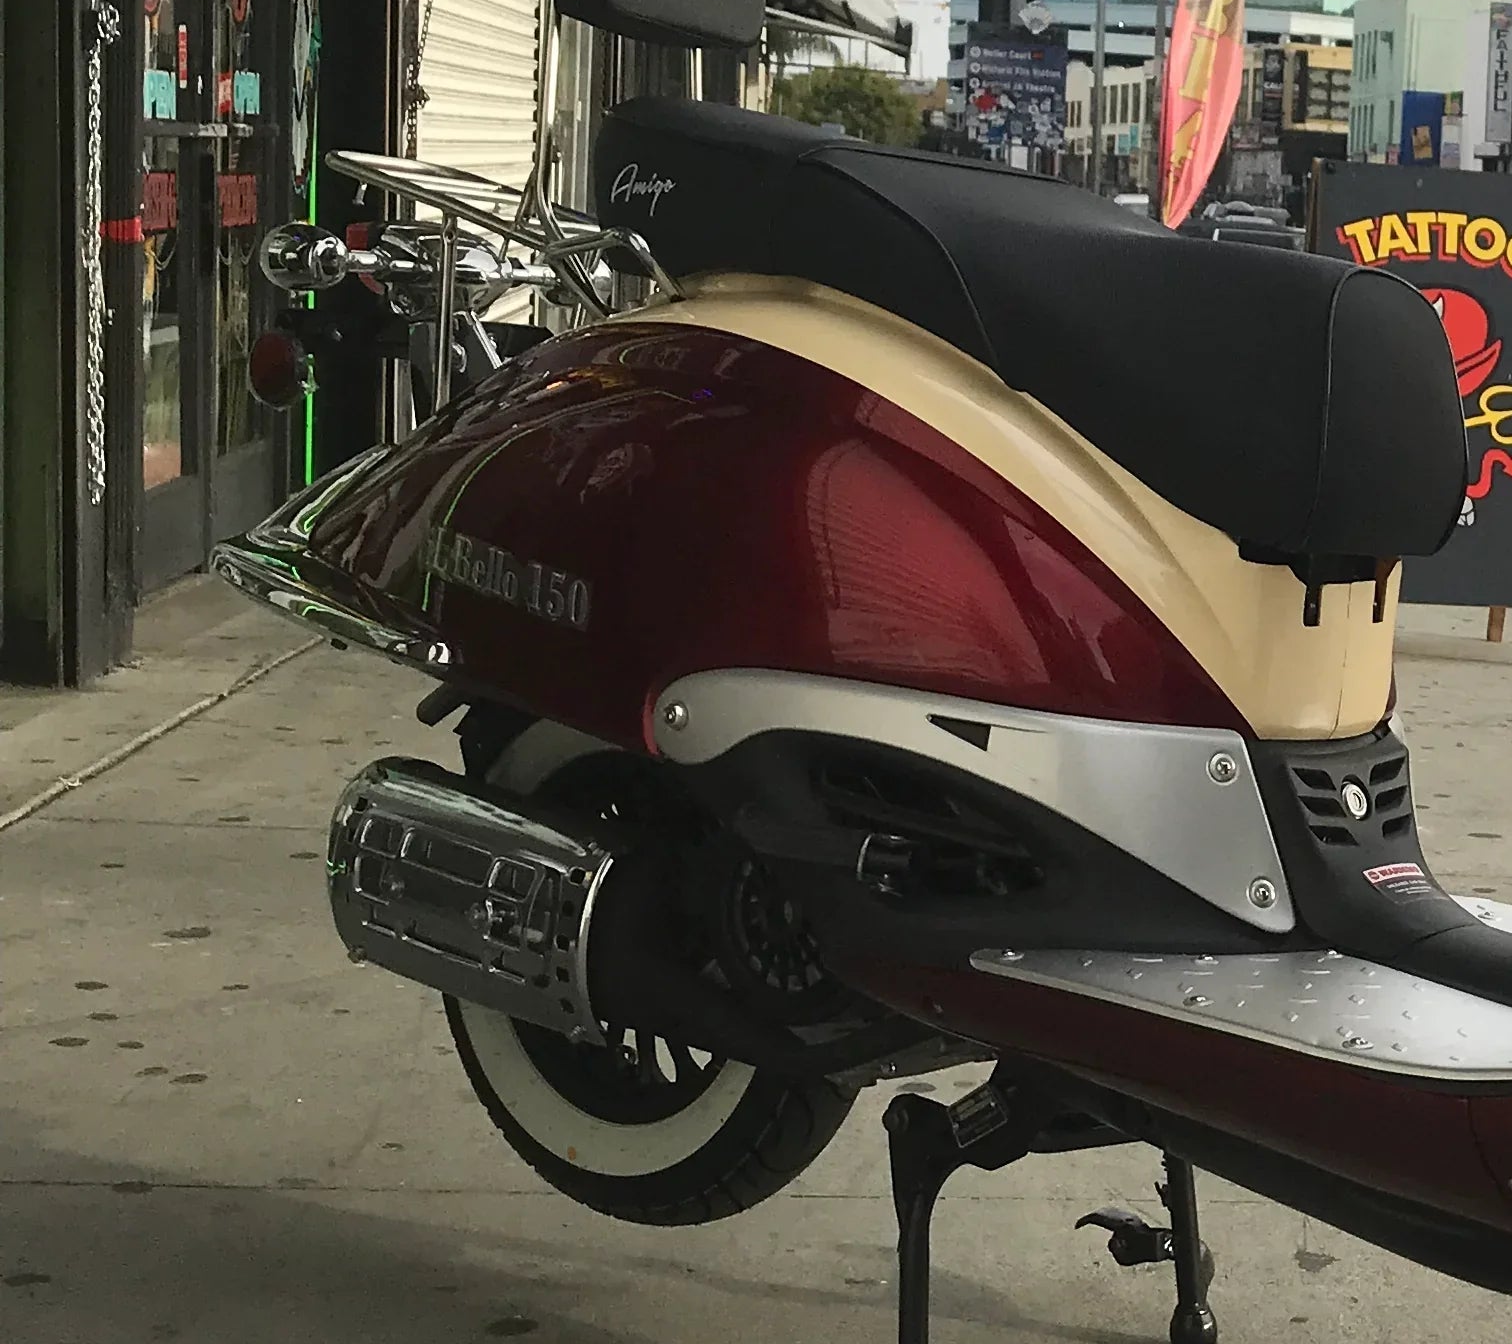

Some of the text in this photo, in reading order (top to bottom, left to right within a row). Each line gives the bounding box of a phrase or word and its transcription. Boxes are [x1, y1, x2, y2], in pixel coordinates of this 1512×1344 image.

[610, 163, 677, 217] Amigo
[453, 532, 520, 601] Bello
[526, 559, 590, 627] 150
